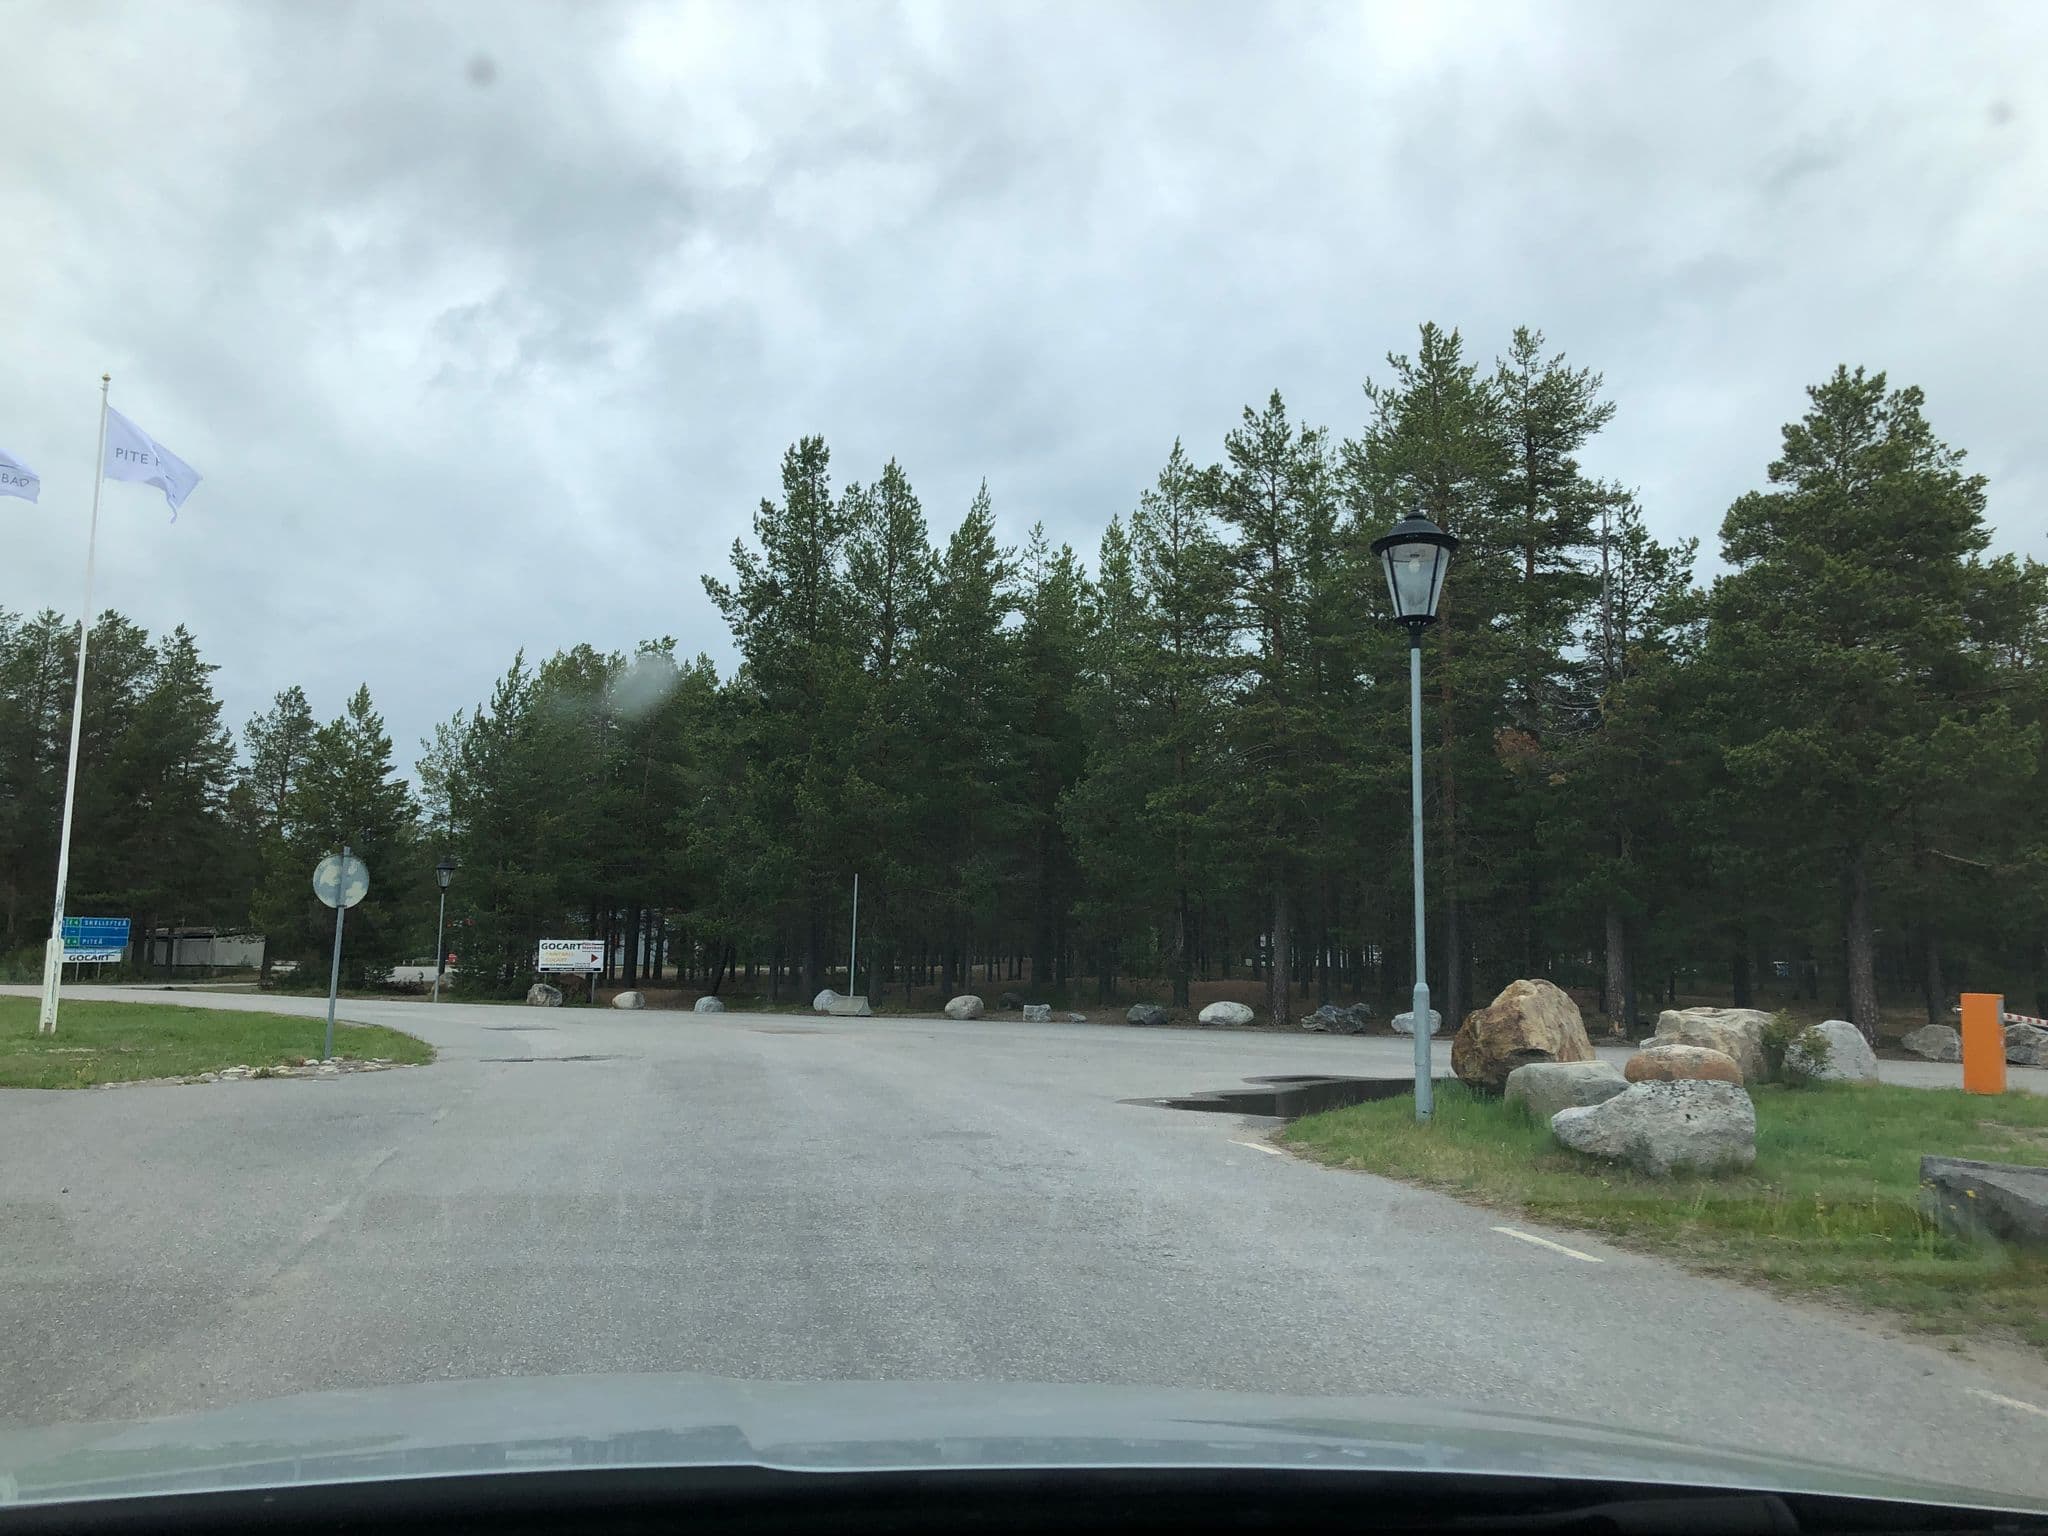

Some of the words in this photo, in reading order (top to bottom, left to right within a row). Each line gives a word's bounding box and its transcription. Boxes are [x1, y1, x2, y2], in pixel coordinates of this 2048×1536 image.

[115, 447, 149, 465] PITE
[1, 472, 30, 488] BAD
[82, 937, 103, 945] PITEÅ
[541, 942, 581, 951] GOCART
